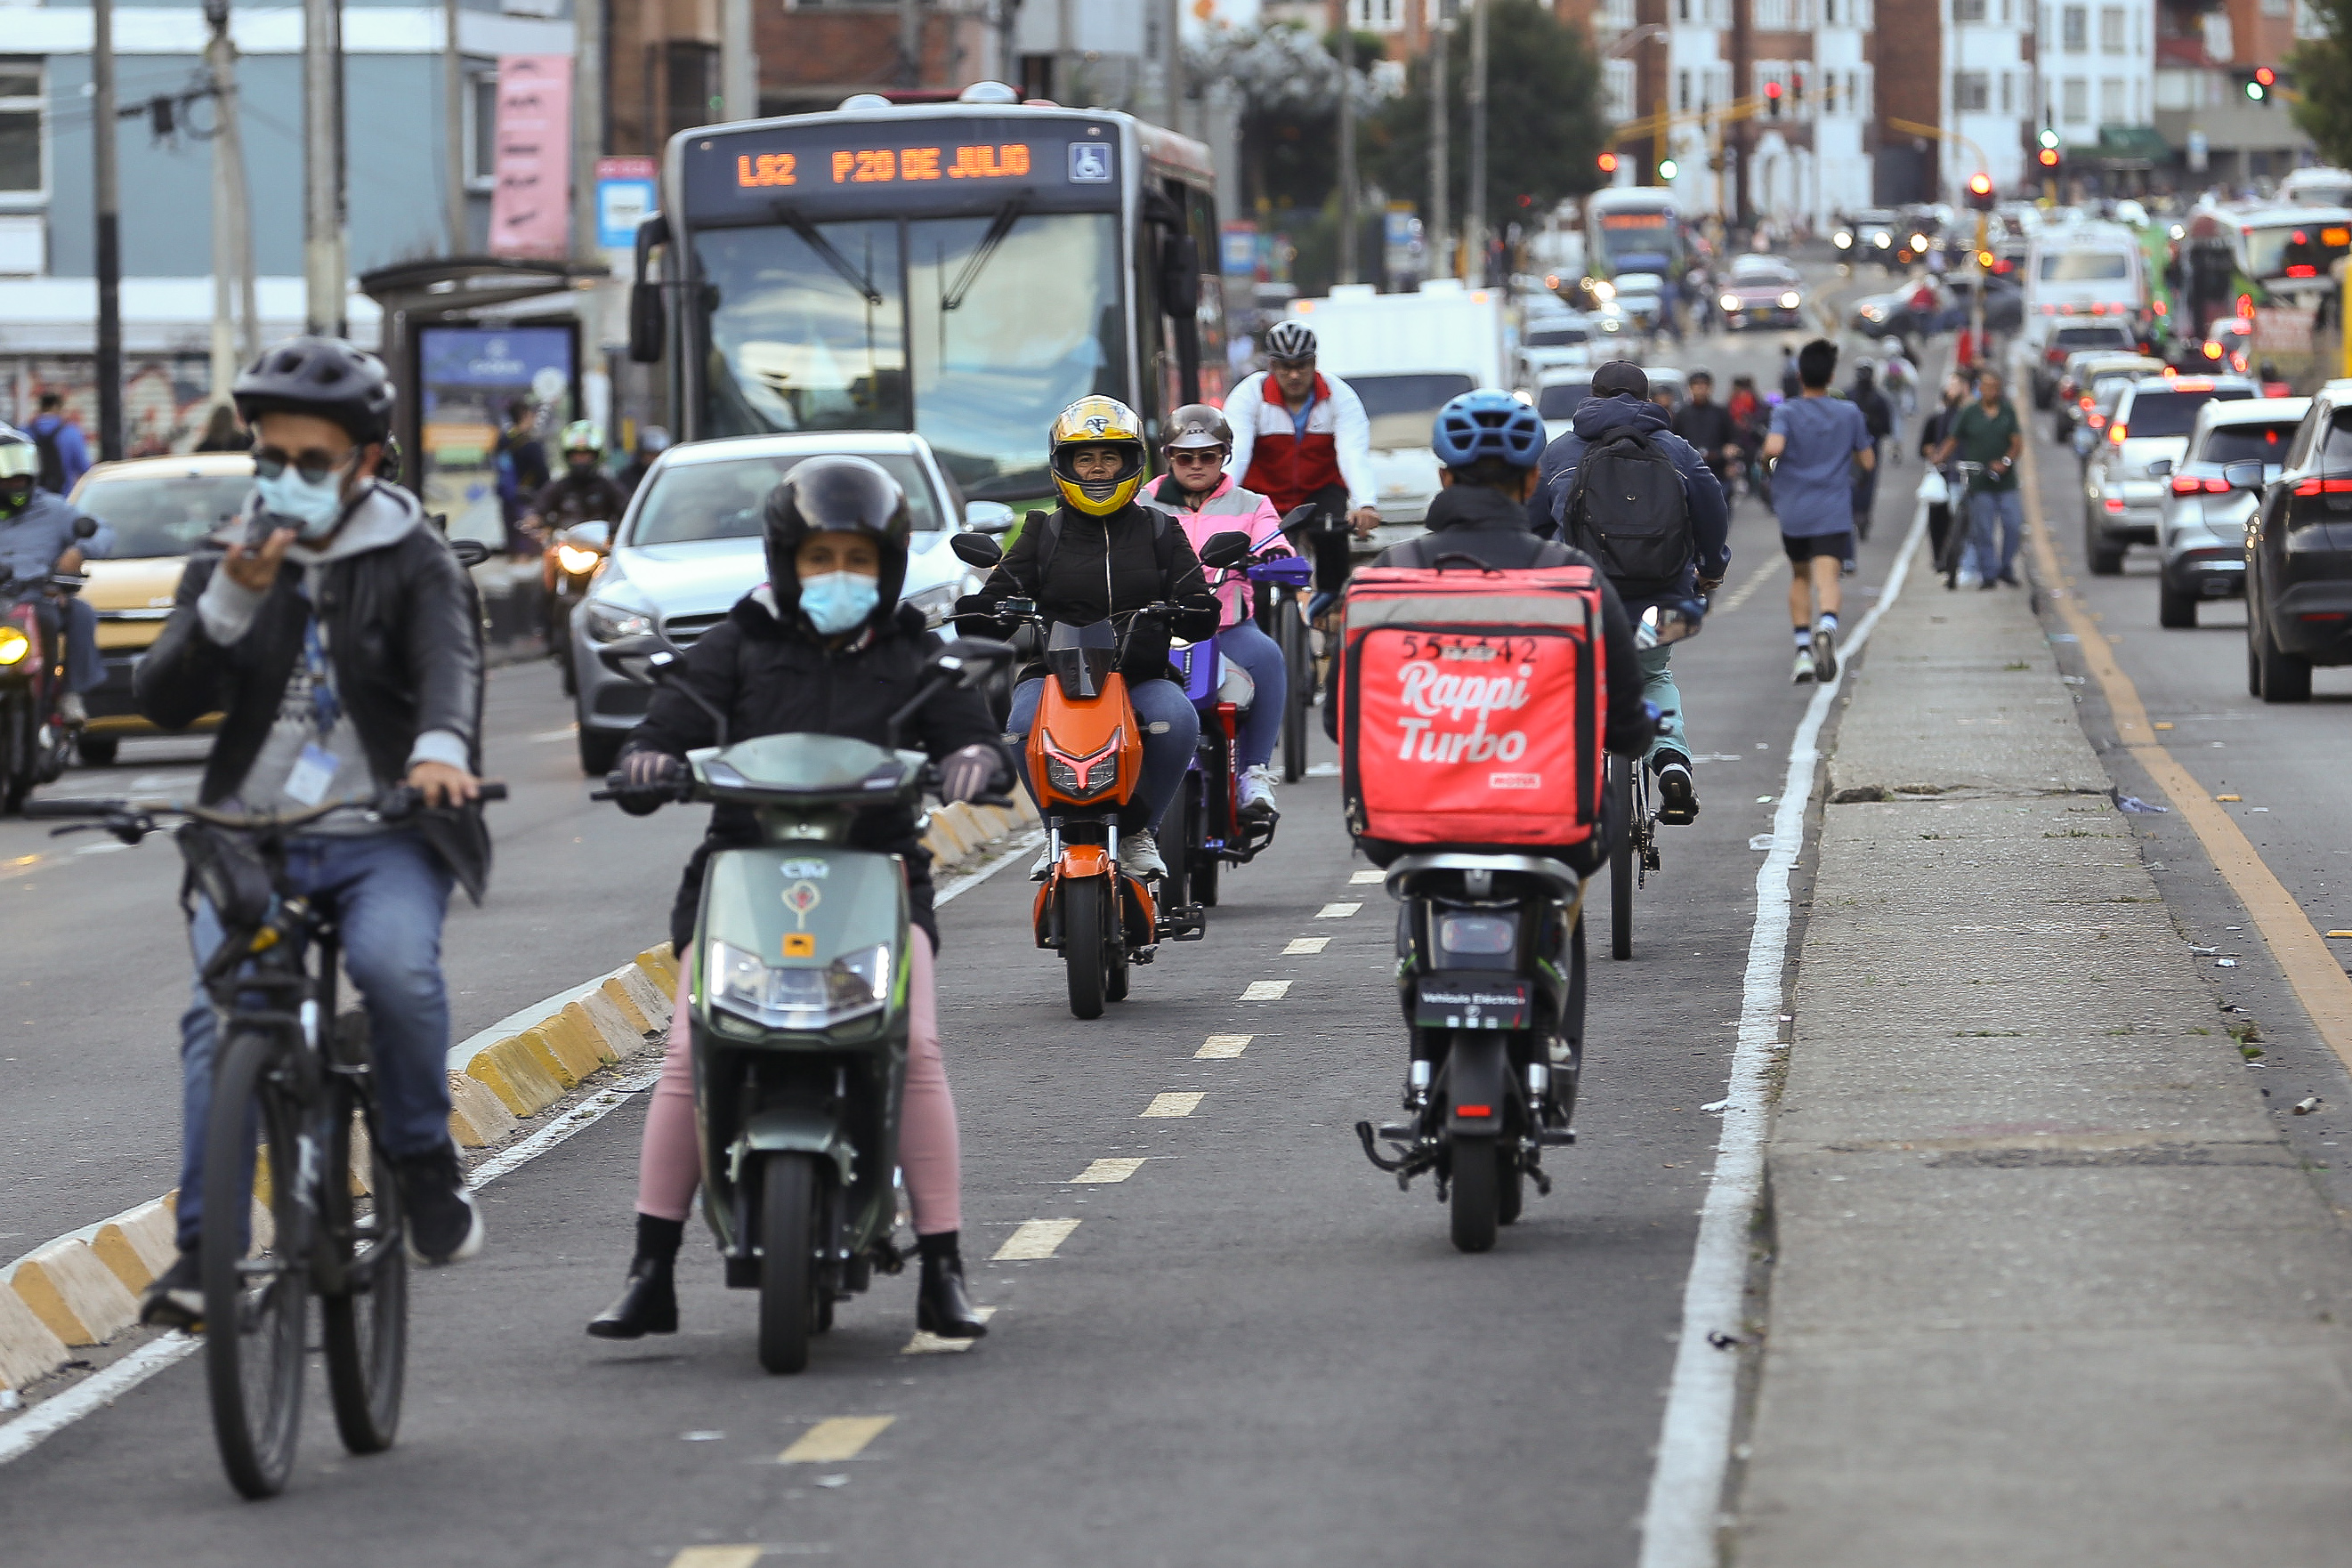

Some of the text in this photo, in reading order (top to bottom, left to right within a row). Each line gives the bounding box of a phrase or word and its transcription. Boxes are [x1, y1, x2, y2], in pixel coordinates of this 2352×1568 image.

[901, 147, 941, 181] DE
[948, 143, 1030, 179] JULIO
[1398, 660, 1532, 722] Rappi
[1398, 715, 1528, 764] Turbo
